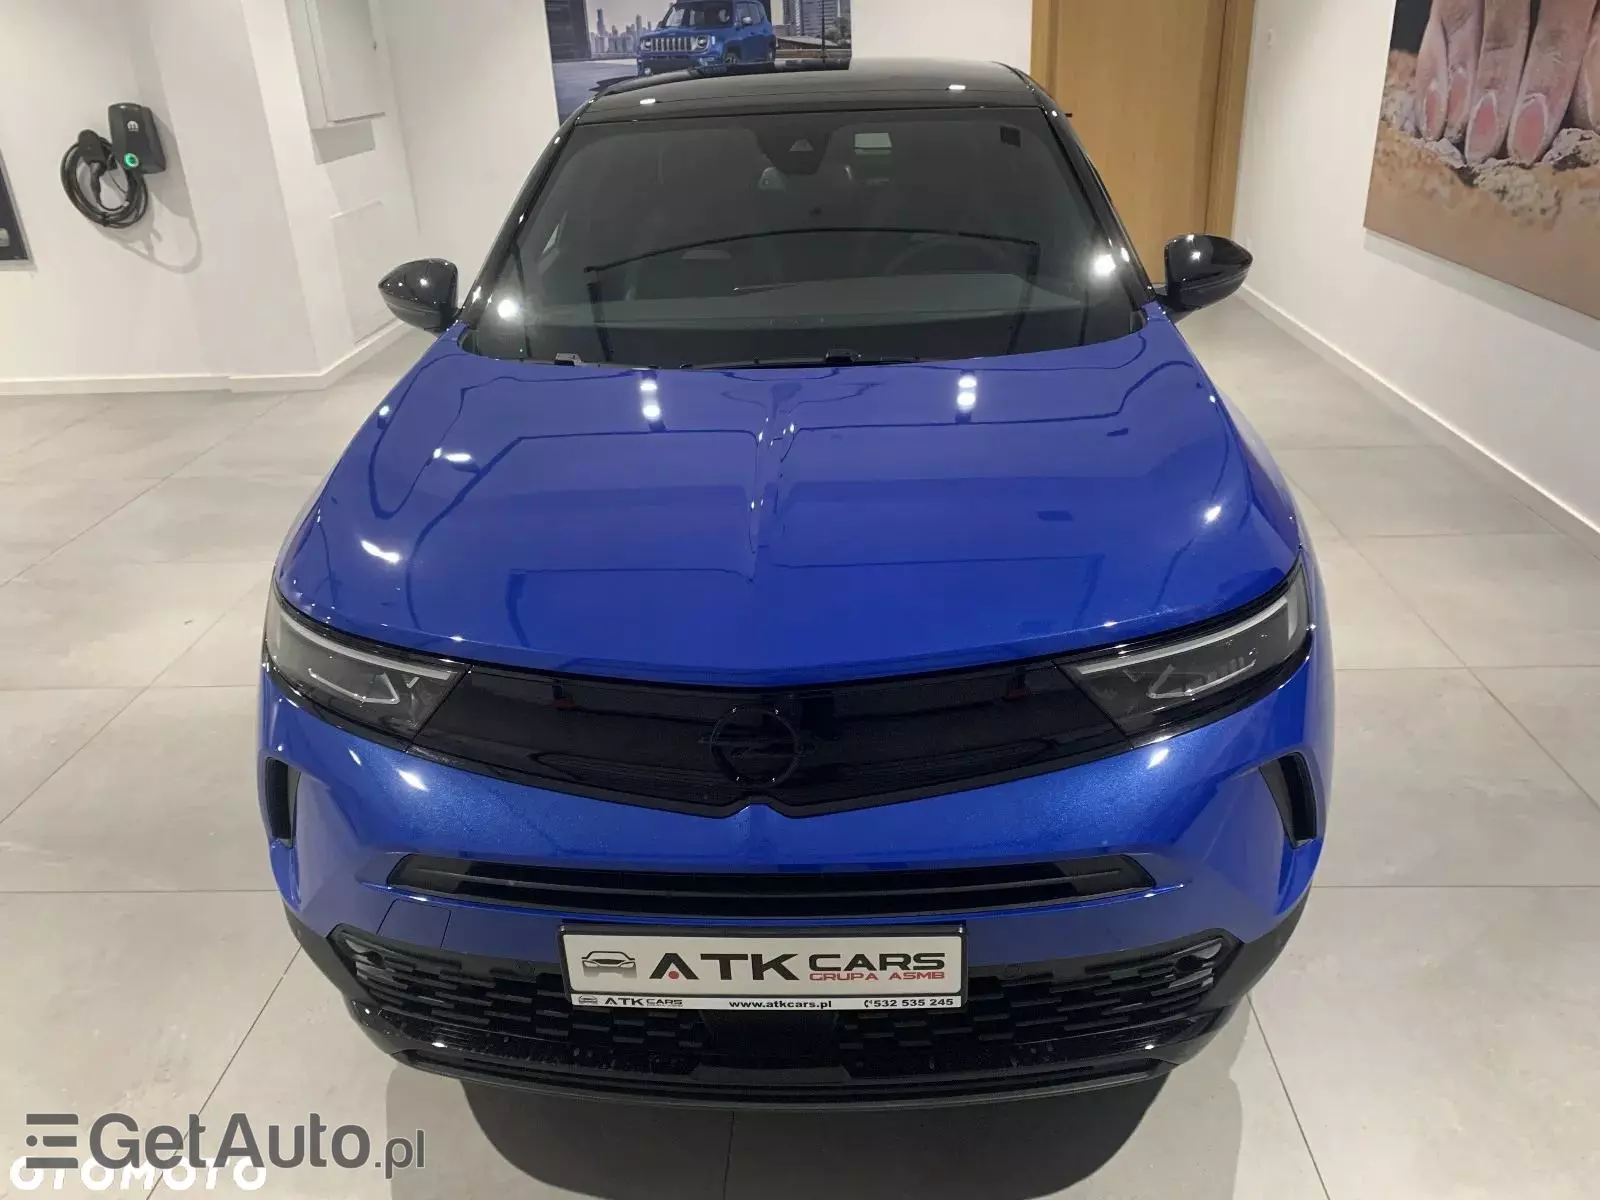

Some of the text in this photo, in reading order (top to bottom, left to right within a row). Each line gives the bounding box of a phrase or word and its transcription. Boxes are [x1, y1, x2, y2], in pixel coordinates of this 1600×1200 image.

[649, 952, 945, 981] ATK CARS
[809, 971, 945, 981] GRUPA ASMB
[604, 998, 643, 1006] ATK
[729, 1000, 832, 1009] www.atkcars.pl
[874, 998, 954, 1007] 532 535 245
